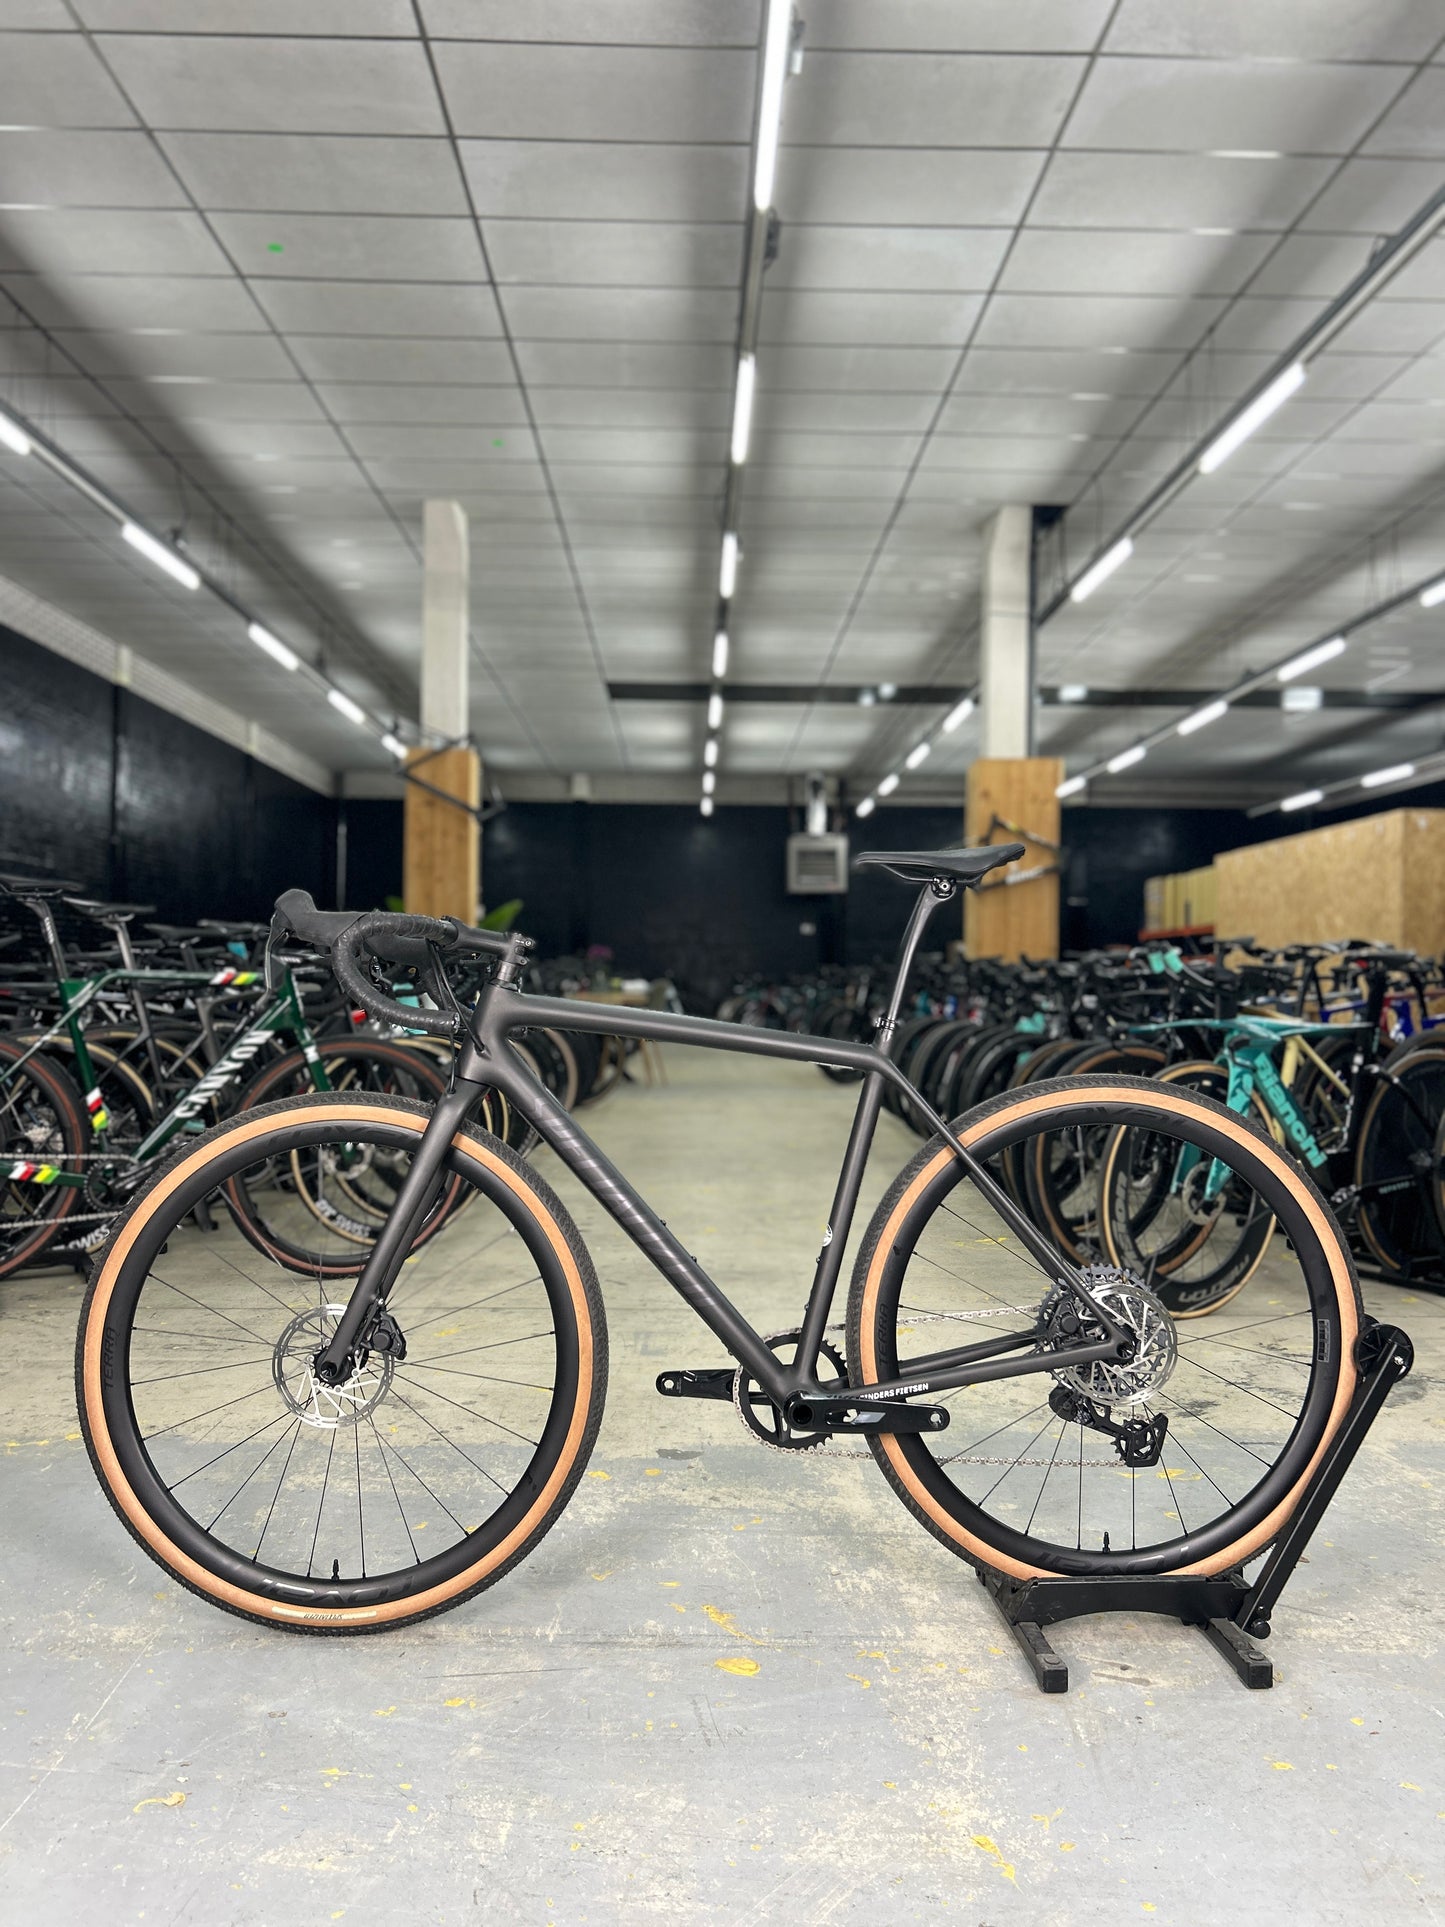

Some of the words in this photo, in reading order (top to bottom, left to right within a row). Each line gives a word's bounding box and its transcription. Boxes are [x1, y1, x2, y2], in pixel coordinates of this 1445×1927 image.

[173, 1029, 276, 1119] CANYON
[1252, 1050, 1328, 1169] Bianchi
[104, 1326, 116, 1390] TERRA
[878, 1303, 888, 1365] TERRA
[895, 1383, 929, 1396] FIETSEN
